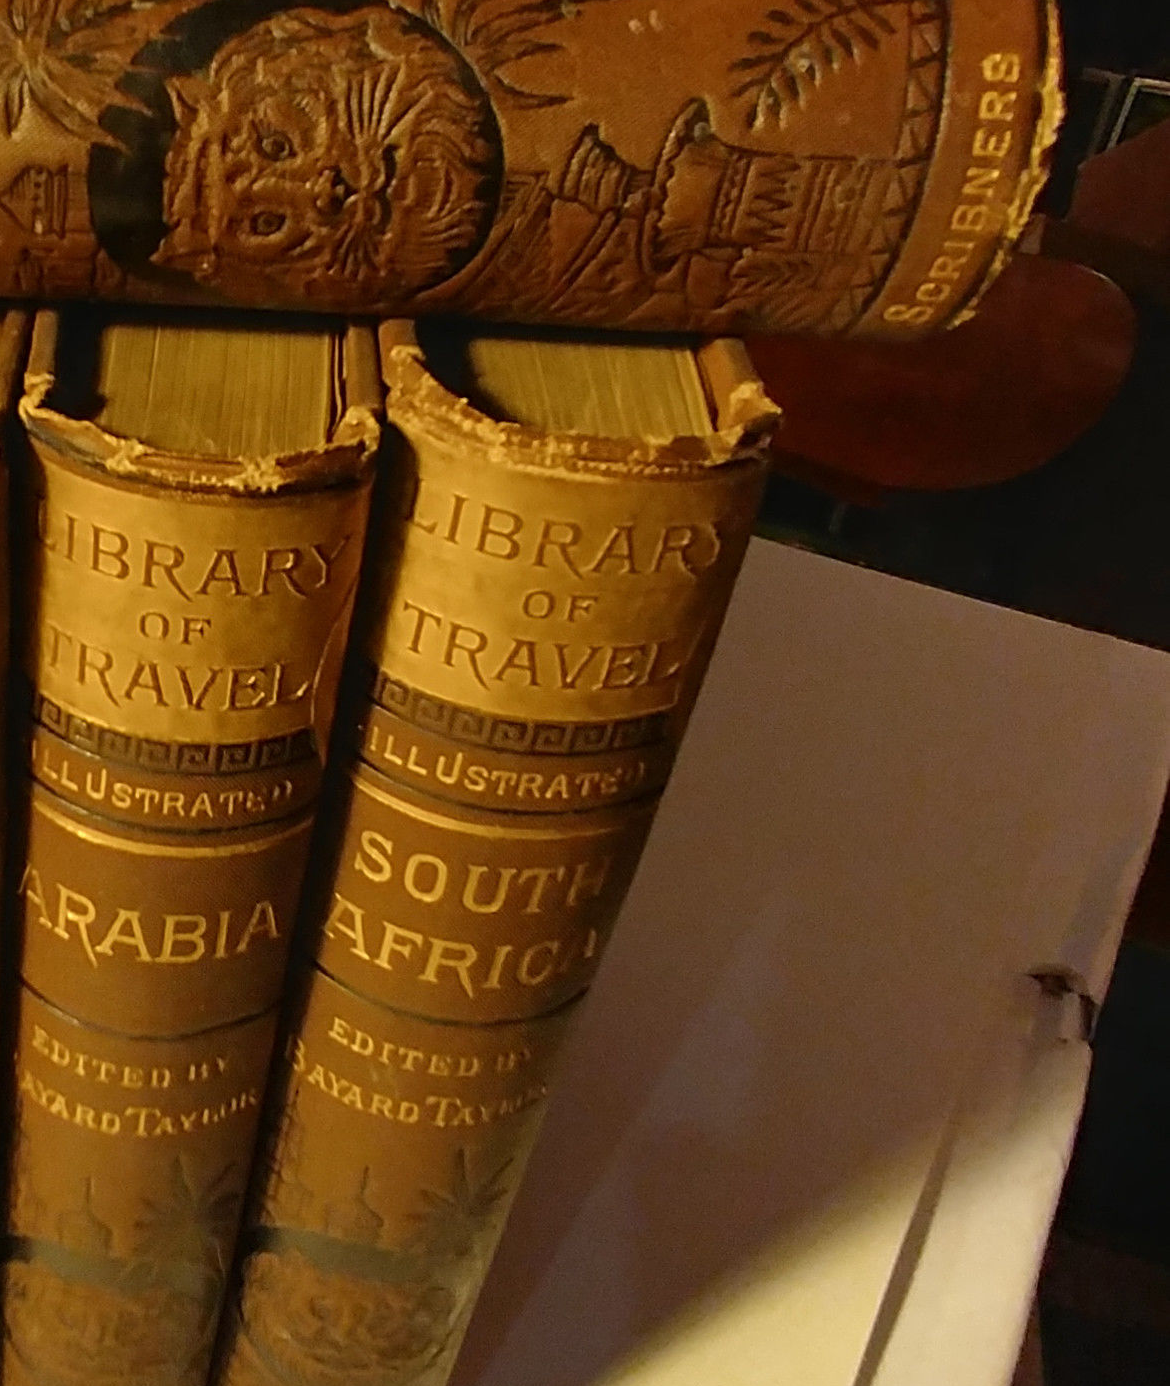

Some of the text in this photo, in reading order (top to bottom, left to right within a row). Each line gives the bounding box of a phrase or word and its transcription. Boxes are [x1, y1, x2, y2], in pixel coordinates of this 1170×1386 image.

[883, 51, 1021, 325] SCRIBNERS
[37, 498, 352, 602] LIBRARY
[138, 612, 213, 646] OF
[403, 600, 682, 692] TRAVEL
[521, 589, 599, 623] OF
[46, 621, 310, 712] TRAVEL
[368, 725, 645, 801] ILLUSTRATE
[353, 829, 612, 914] SOUTH
[18, 863, 281, 969] ARABIA
[31, 1023, 172, 1089] EDITED
[290, 1037, 420, 1125] BAYARD
[327, 1015, 479, 1078] EDITED
[20, 1068, 122, 1136] AYARD
